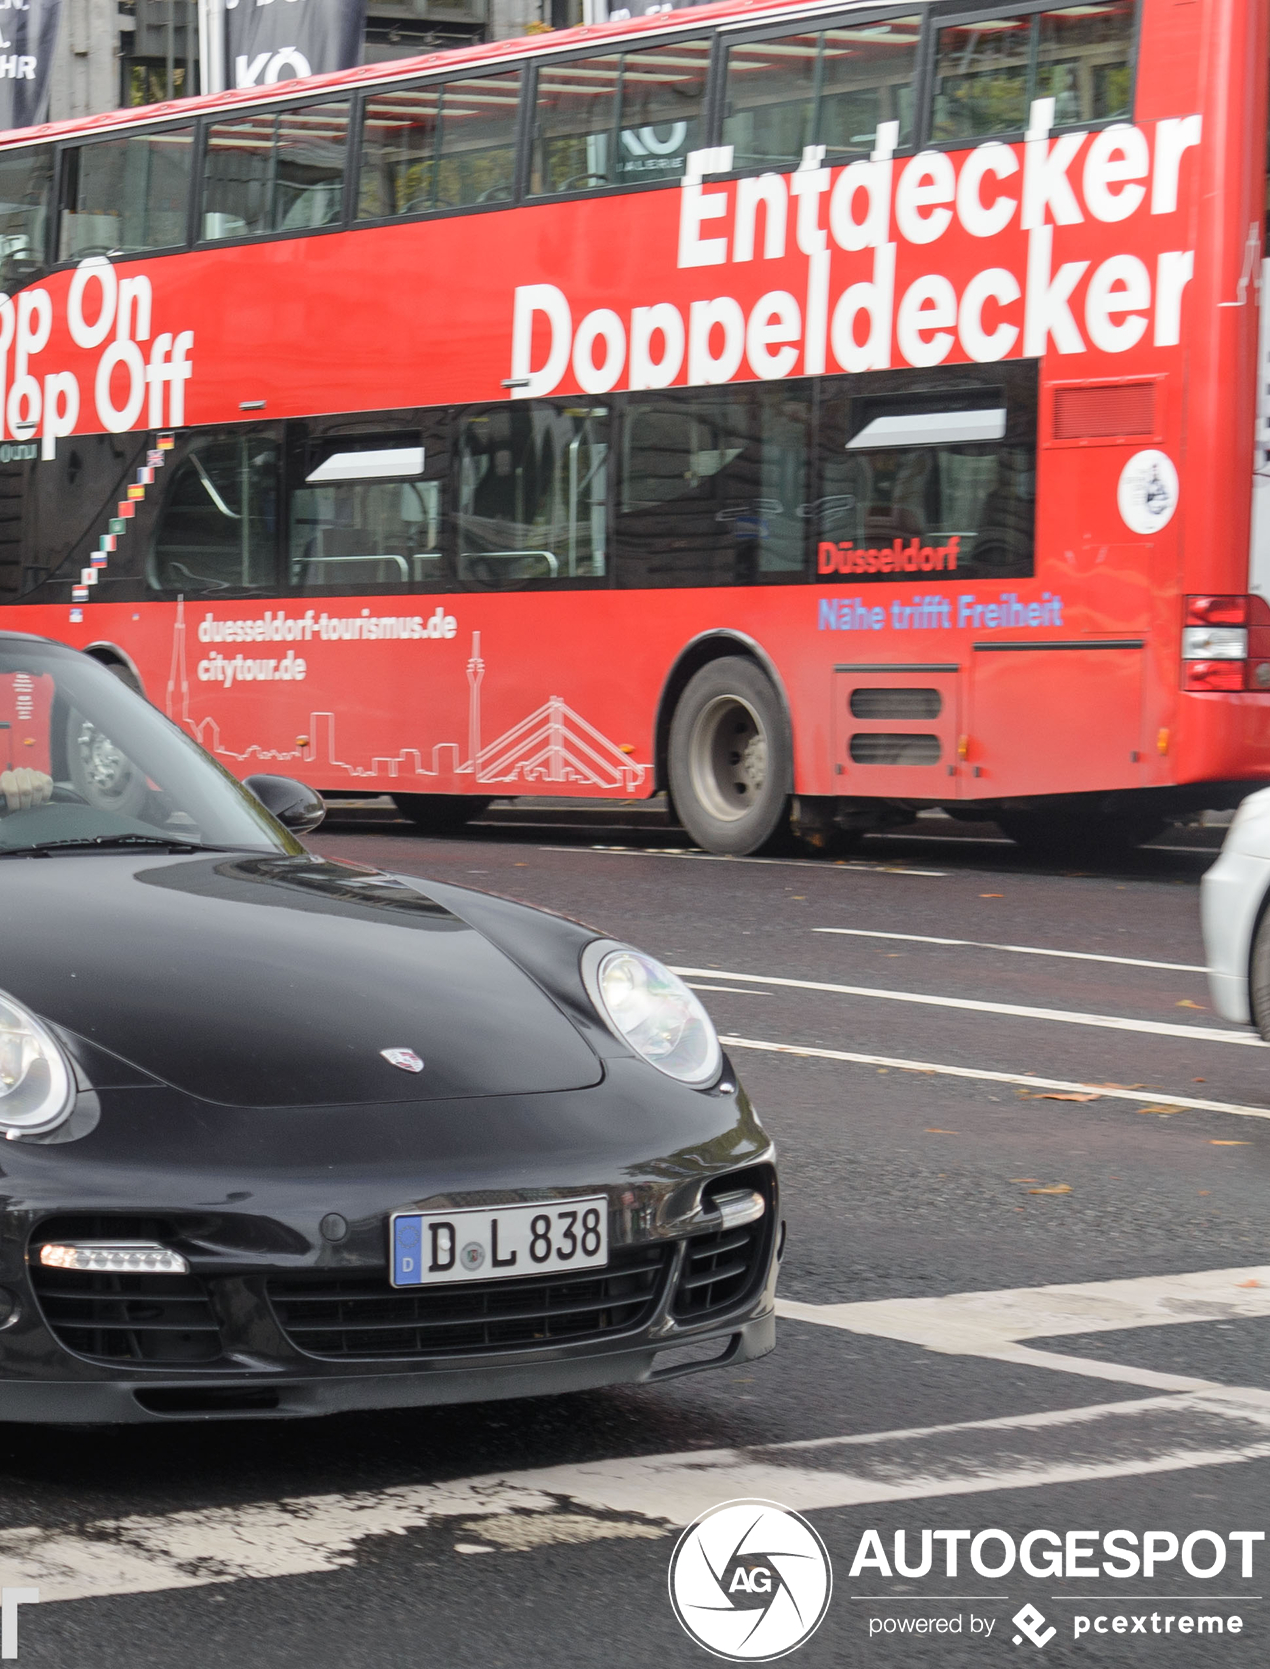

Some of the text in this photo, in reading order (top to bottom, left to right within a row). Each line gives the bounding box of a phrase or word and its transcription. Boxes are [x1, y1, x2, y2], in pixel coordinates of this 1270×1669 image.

[677, 97, 1202, 269] Entdecker
[67, 256, 153, 348] On
[511, 224, 1194, 399] Doppeldecker
[95, 330, 194, 434] Off
[818, 536, 961, 575] Düsseldorf
[198, 606, 458, 643] duesseldorf-tourismus.de
[818, 592, 1065, 631] Nähe trifft Freiheit
[197, 650, 307, 688] citytour.de
[402, 1257, 414, 1273] D
[428, 1208, 602, 1272] D L 838
